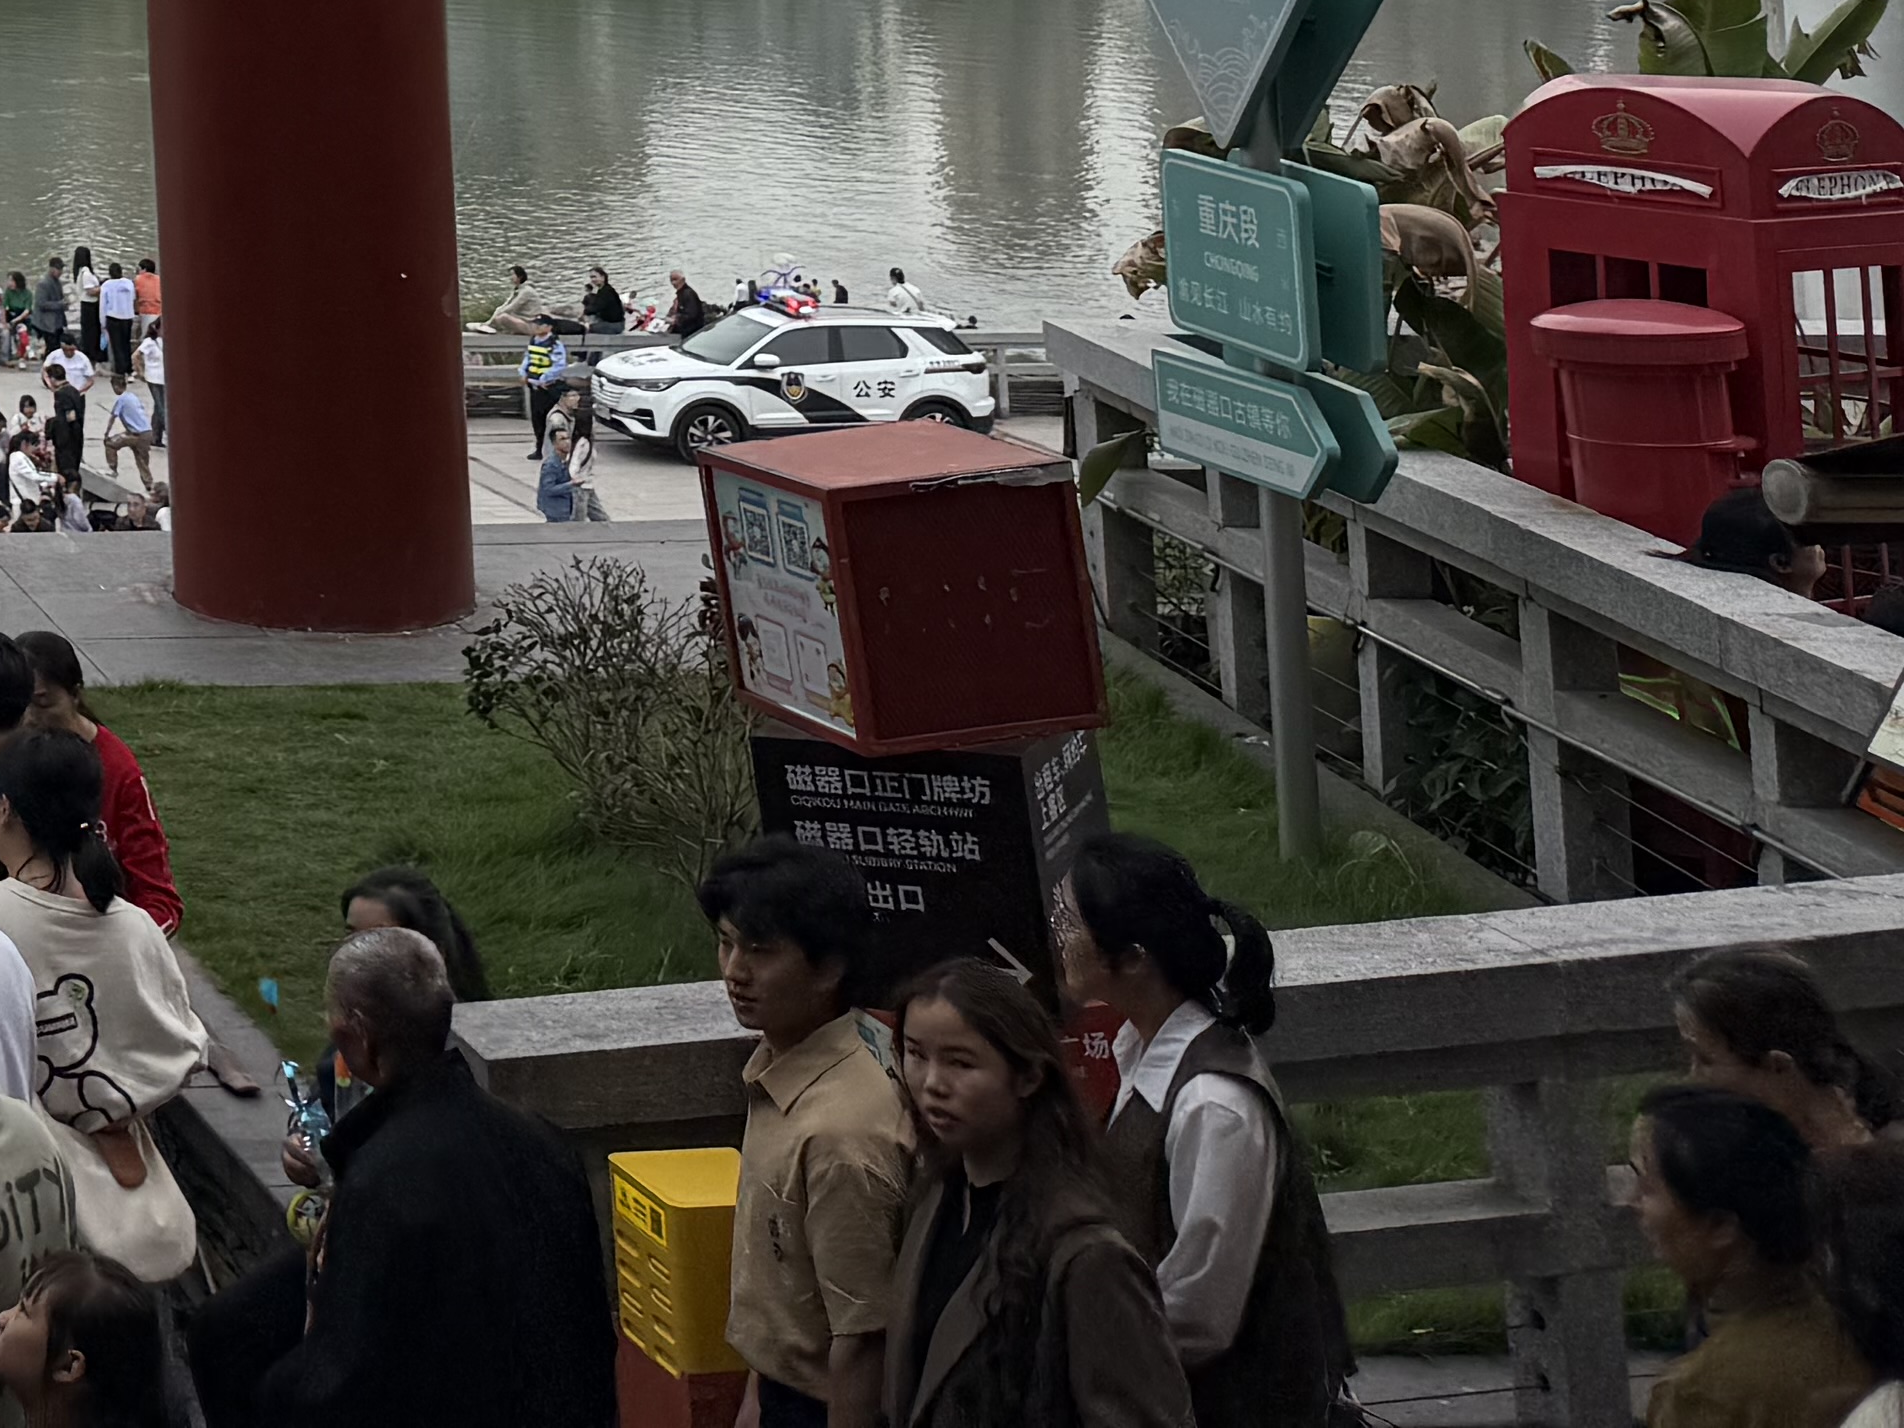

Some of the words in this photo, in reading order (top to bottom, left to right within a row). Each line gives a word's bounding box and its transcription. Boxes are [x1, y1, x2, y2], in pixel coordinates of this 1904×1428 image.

[1197, 194, 1260, 249] 重庆段
[1204, 251, 1260, 283] CHONGQING
[1238, 296, 1293, 337] 山水有约
[852, 379, 896, 399] 公安
[1167, 378, 1292, 440] 我在磁器口古镇等你
[784, 764, 992, 806] 磁器口正门牌坊
[793, 819, 982, 862] 磁器口轻轨站
[865, 880, 925, 913] 出口
